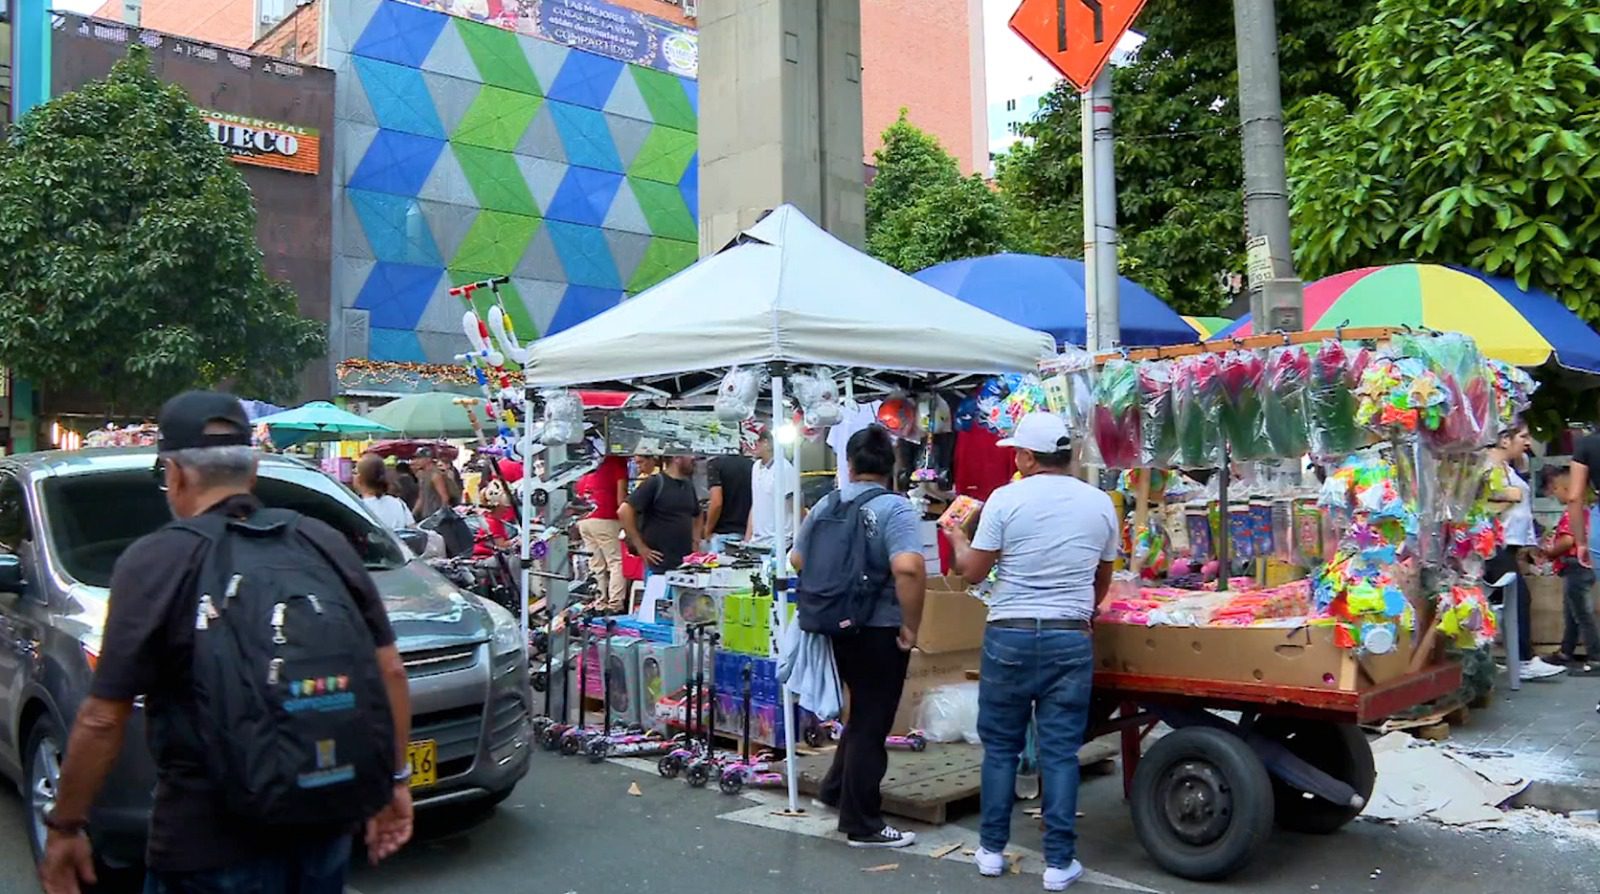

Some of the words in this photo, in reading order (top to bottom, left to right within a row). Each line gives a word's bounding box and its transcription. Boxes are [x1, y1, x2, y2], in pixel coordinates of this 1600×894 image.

[583, 4, 626, 24] MEJORES
[587, 15, 600, 26] DE
[554, 28, 634, 58] COMPARTIDAS
[198, 109, 307, 135] COMERCIAL
[207, 121, 298, 156] UECO
[409, 748, 432, 775] 16
